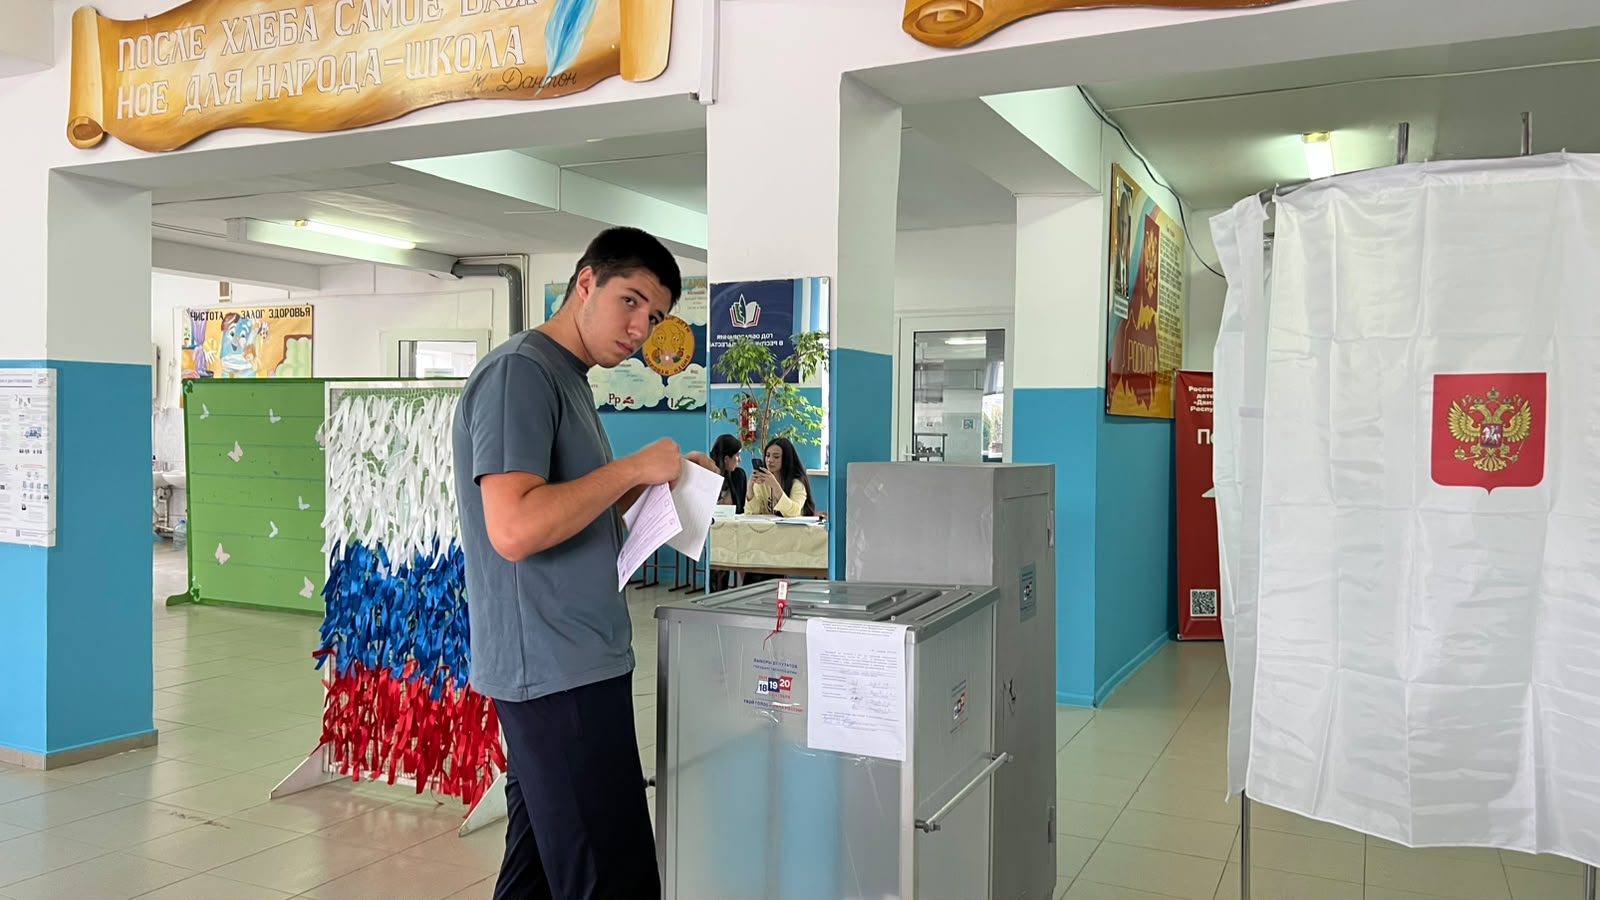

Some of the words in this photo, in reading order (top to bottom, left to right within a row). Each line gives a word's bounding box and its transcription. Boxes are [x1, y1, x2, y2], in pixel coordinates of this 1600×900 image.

[117, 25, 206, 72] ПОСЛЕ
[219, 6, 319, 56] ХЛЕБА
[334, 0, 444, 37] САМОЕ
[116, 80, 170, 120] НОЕ
[183, 69, 243, 116] ДЛЯ
[190, 311, 224, 321] ЧИСТОТА
[240, 310, 265, 319] ЗАЛОГ
[268, 307, 311, 319] ЗДОРОВЬЯ
[1188, 385, 1214, 393] Росси
[759, 683, 768, 692] 18
[769, 680, 778, 690] 19
[779, 678, 791, 688] 20
